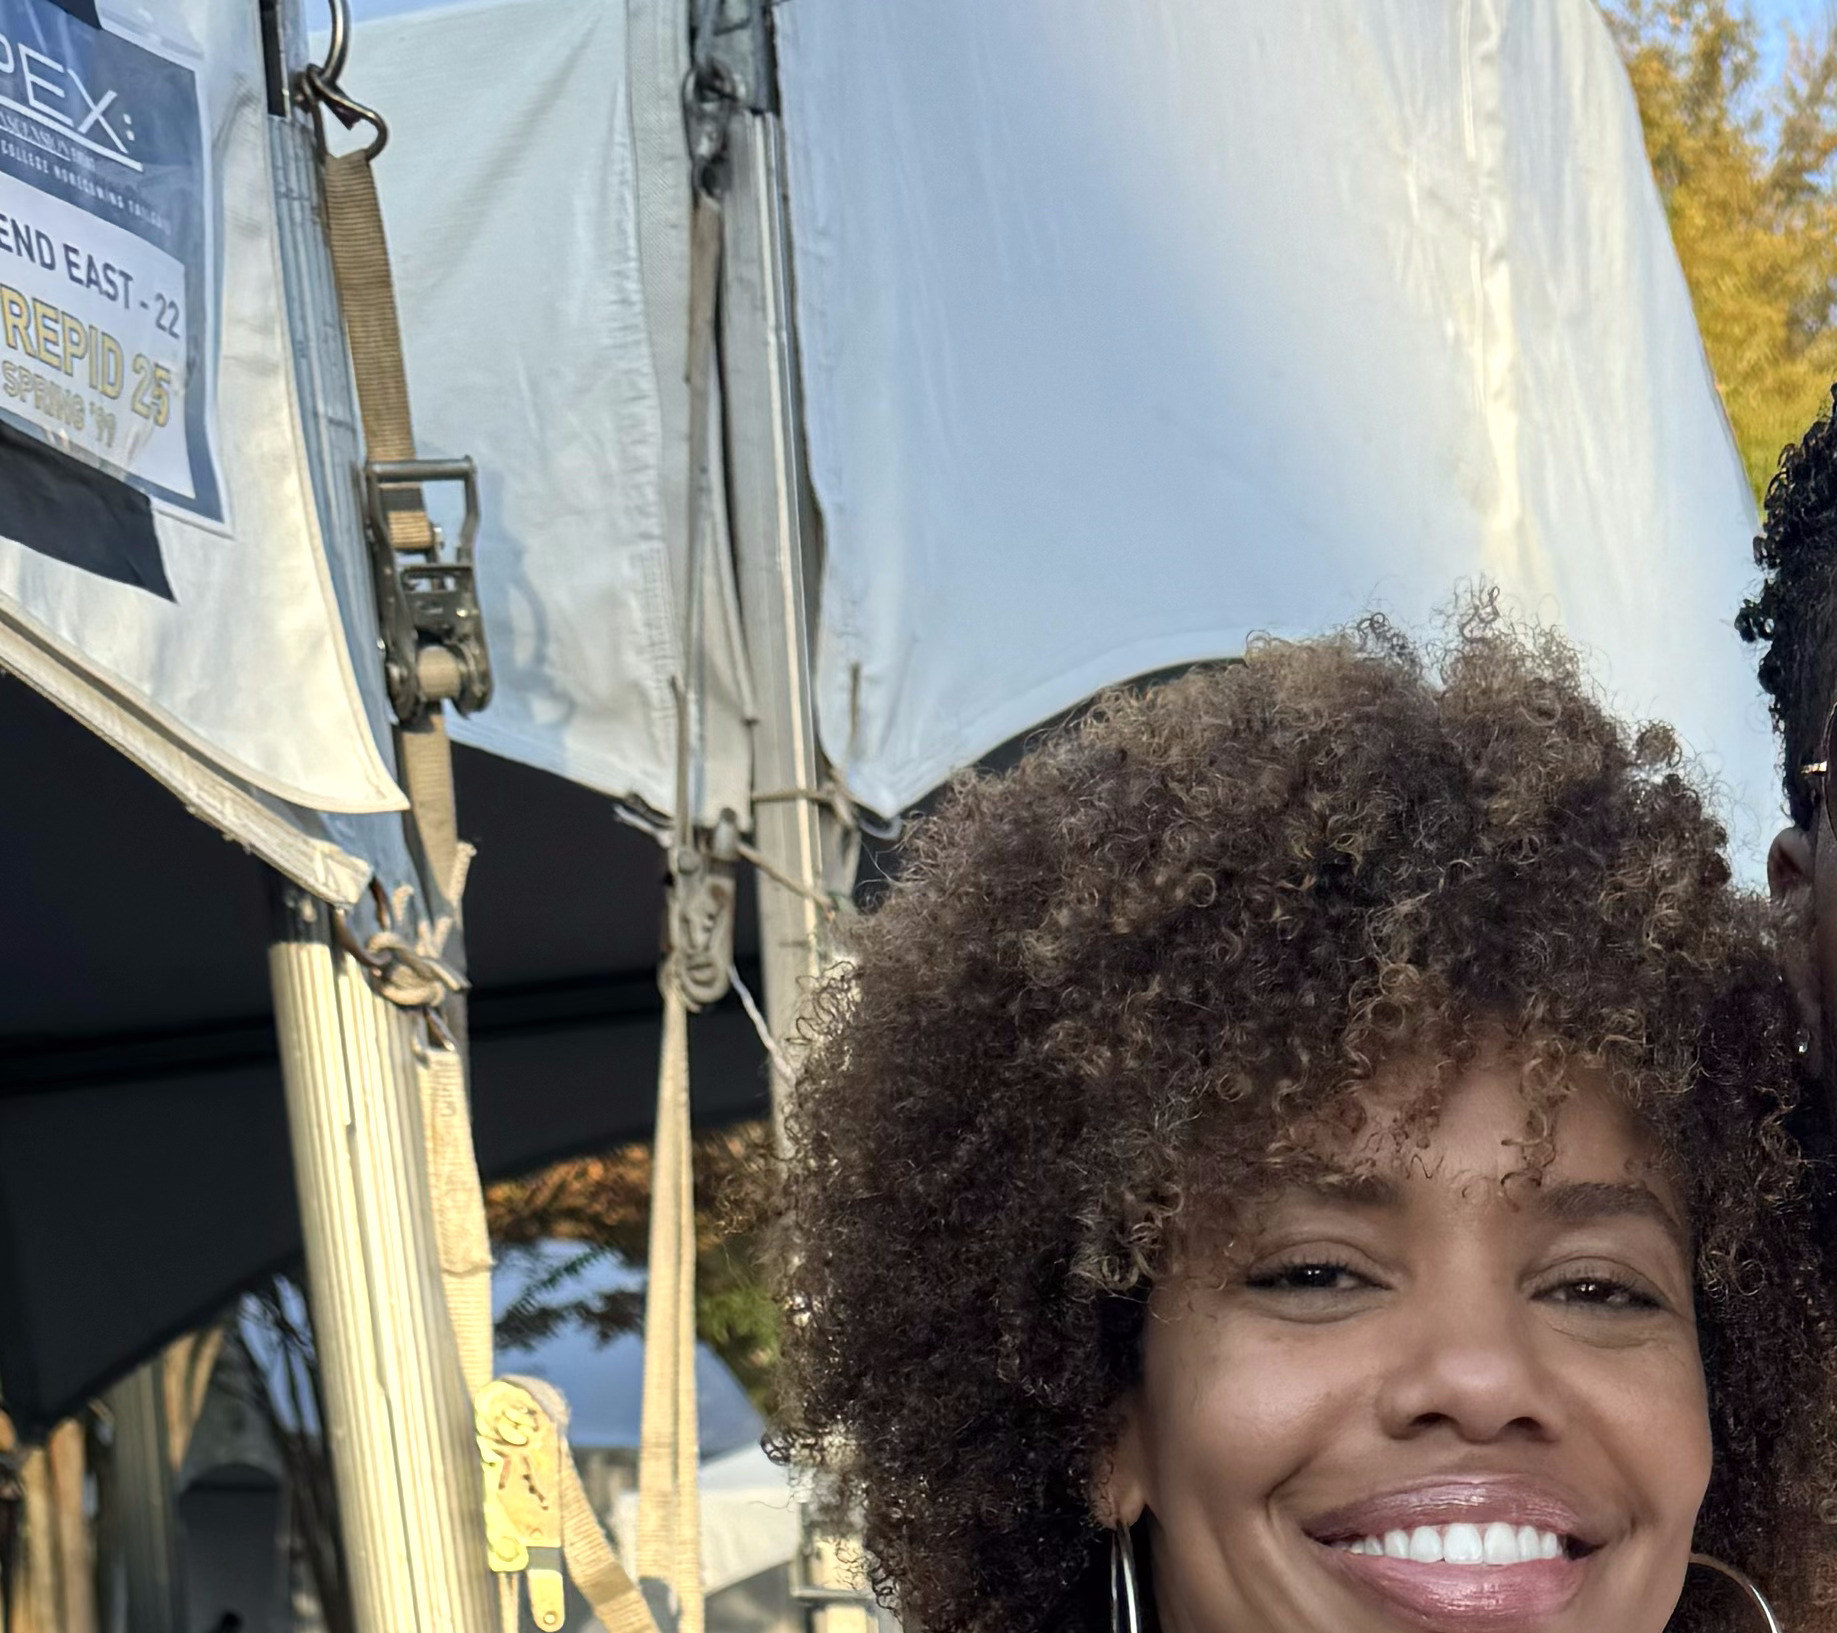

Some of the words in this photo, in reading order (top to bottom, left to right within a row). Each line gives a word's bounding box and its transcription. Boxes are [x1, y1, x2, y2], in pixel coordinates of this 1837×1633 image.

[62, 243, 134, 309] EAST
[155, 292, 180, 339] 22
[0, 283, 124, 400] REPID
[131, 352, 172, 428] 25
[2, 360, 85, 430] SPRING
